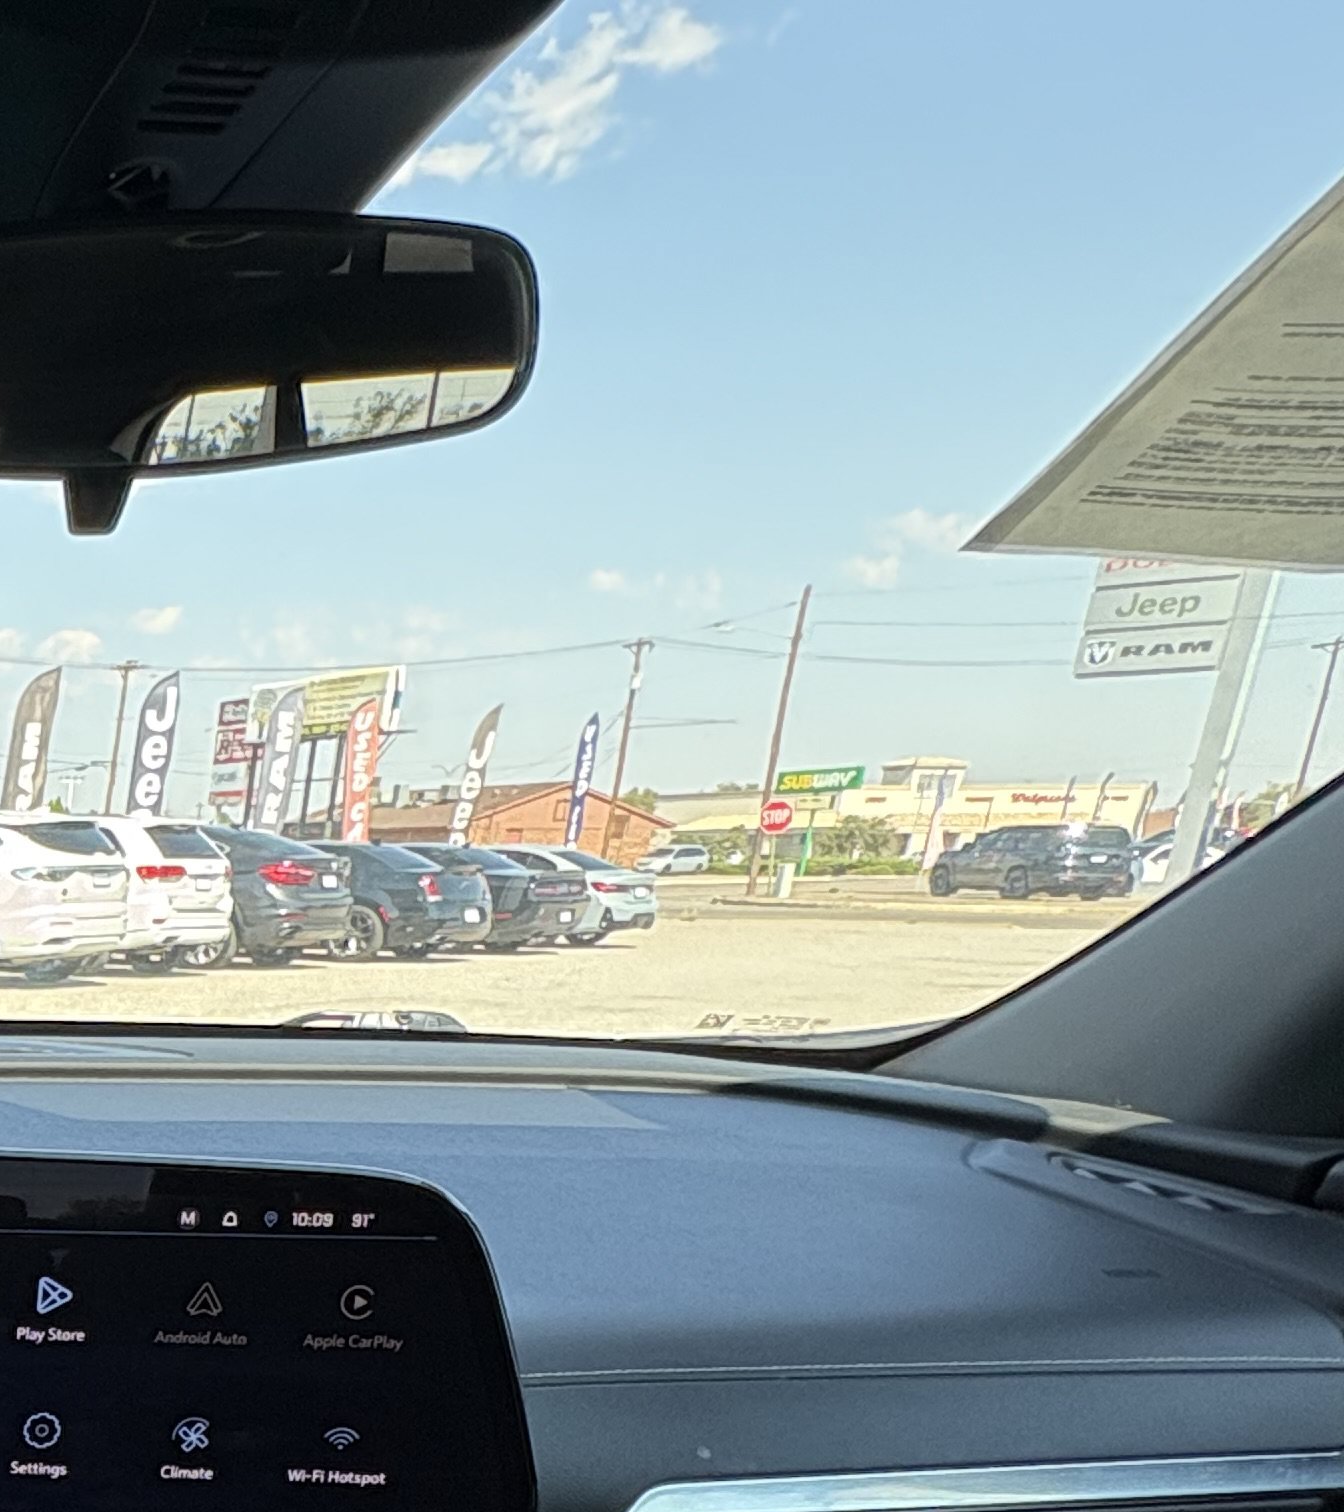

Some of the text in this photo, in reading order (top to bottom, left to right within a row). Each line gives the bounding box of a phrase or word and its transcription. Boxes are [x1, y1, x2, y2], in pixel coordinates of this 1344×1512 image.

[1115, 592, 1201, 618] Jeep
[1120, 640, 1213, 658] RAM
[134, 685, 178, 818] Jee
[352, 711, 376, 793] USED
[779, 771, 857, 791] SUBWAY
[762, 808, 790, 826] STOP
[291, 1212, 334, 1229] 10:09
[15, 1326, 86, 1344] Play Store
[153, 1330, 248, 1347] Android Auto
[303, 1333, 404, 1353] Apple CarPlay
[10, 1460, 68, 1479] Settings
[160, 1464, 214, 1481] Climate
[287, 1468, 387, 1488] Wi-Fi Hotspot
